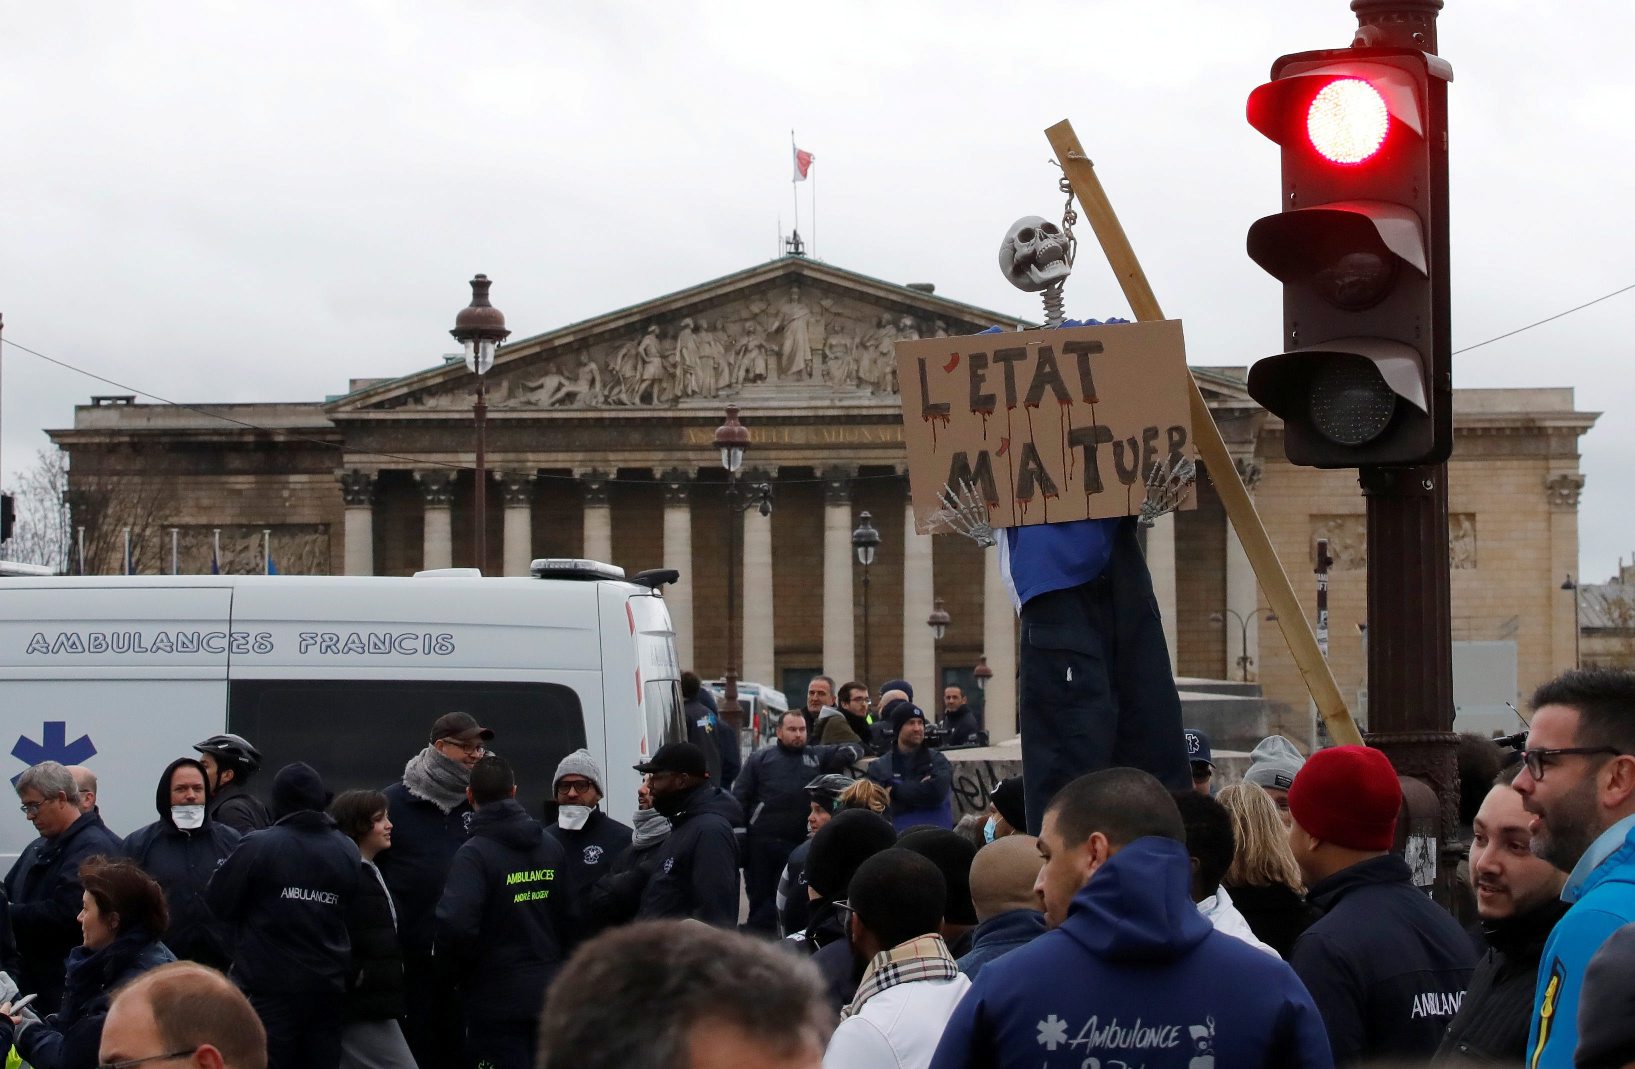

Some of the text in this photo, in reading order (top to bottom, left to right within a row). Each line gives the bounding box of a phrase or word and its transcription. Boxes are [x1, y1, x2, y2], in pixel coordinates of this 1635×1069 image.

[917, 340, 1104, 418] L'ETAT
[25, 631, 456, 656] AMBULANCES FRANCIS
[506, 869, 555, 885] AMBULANCES
